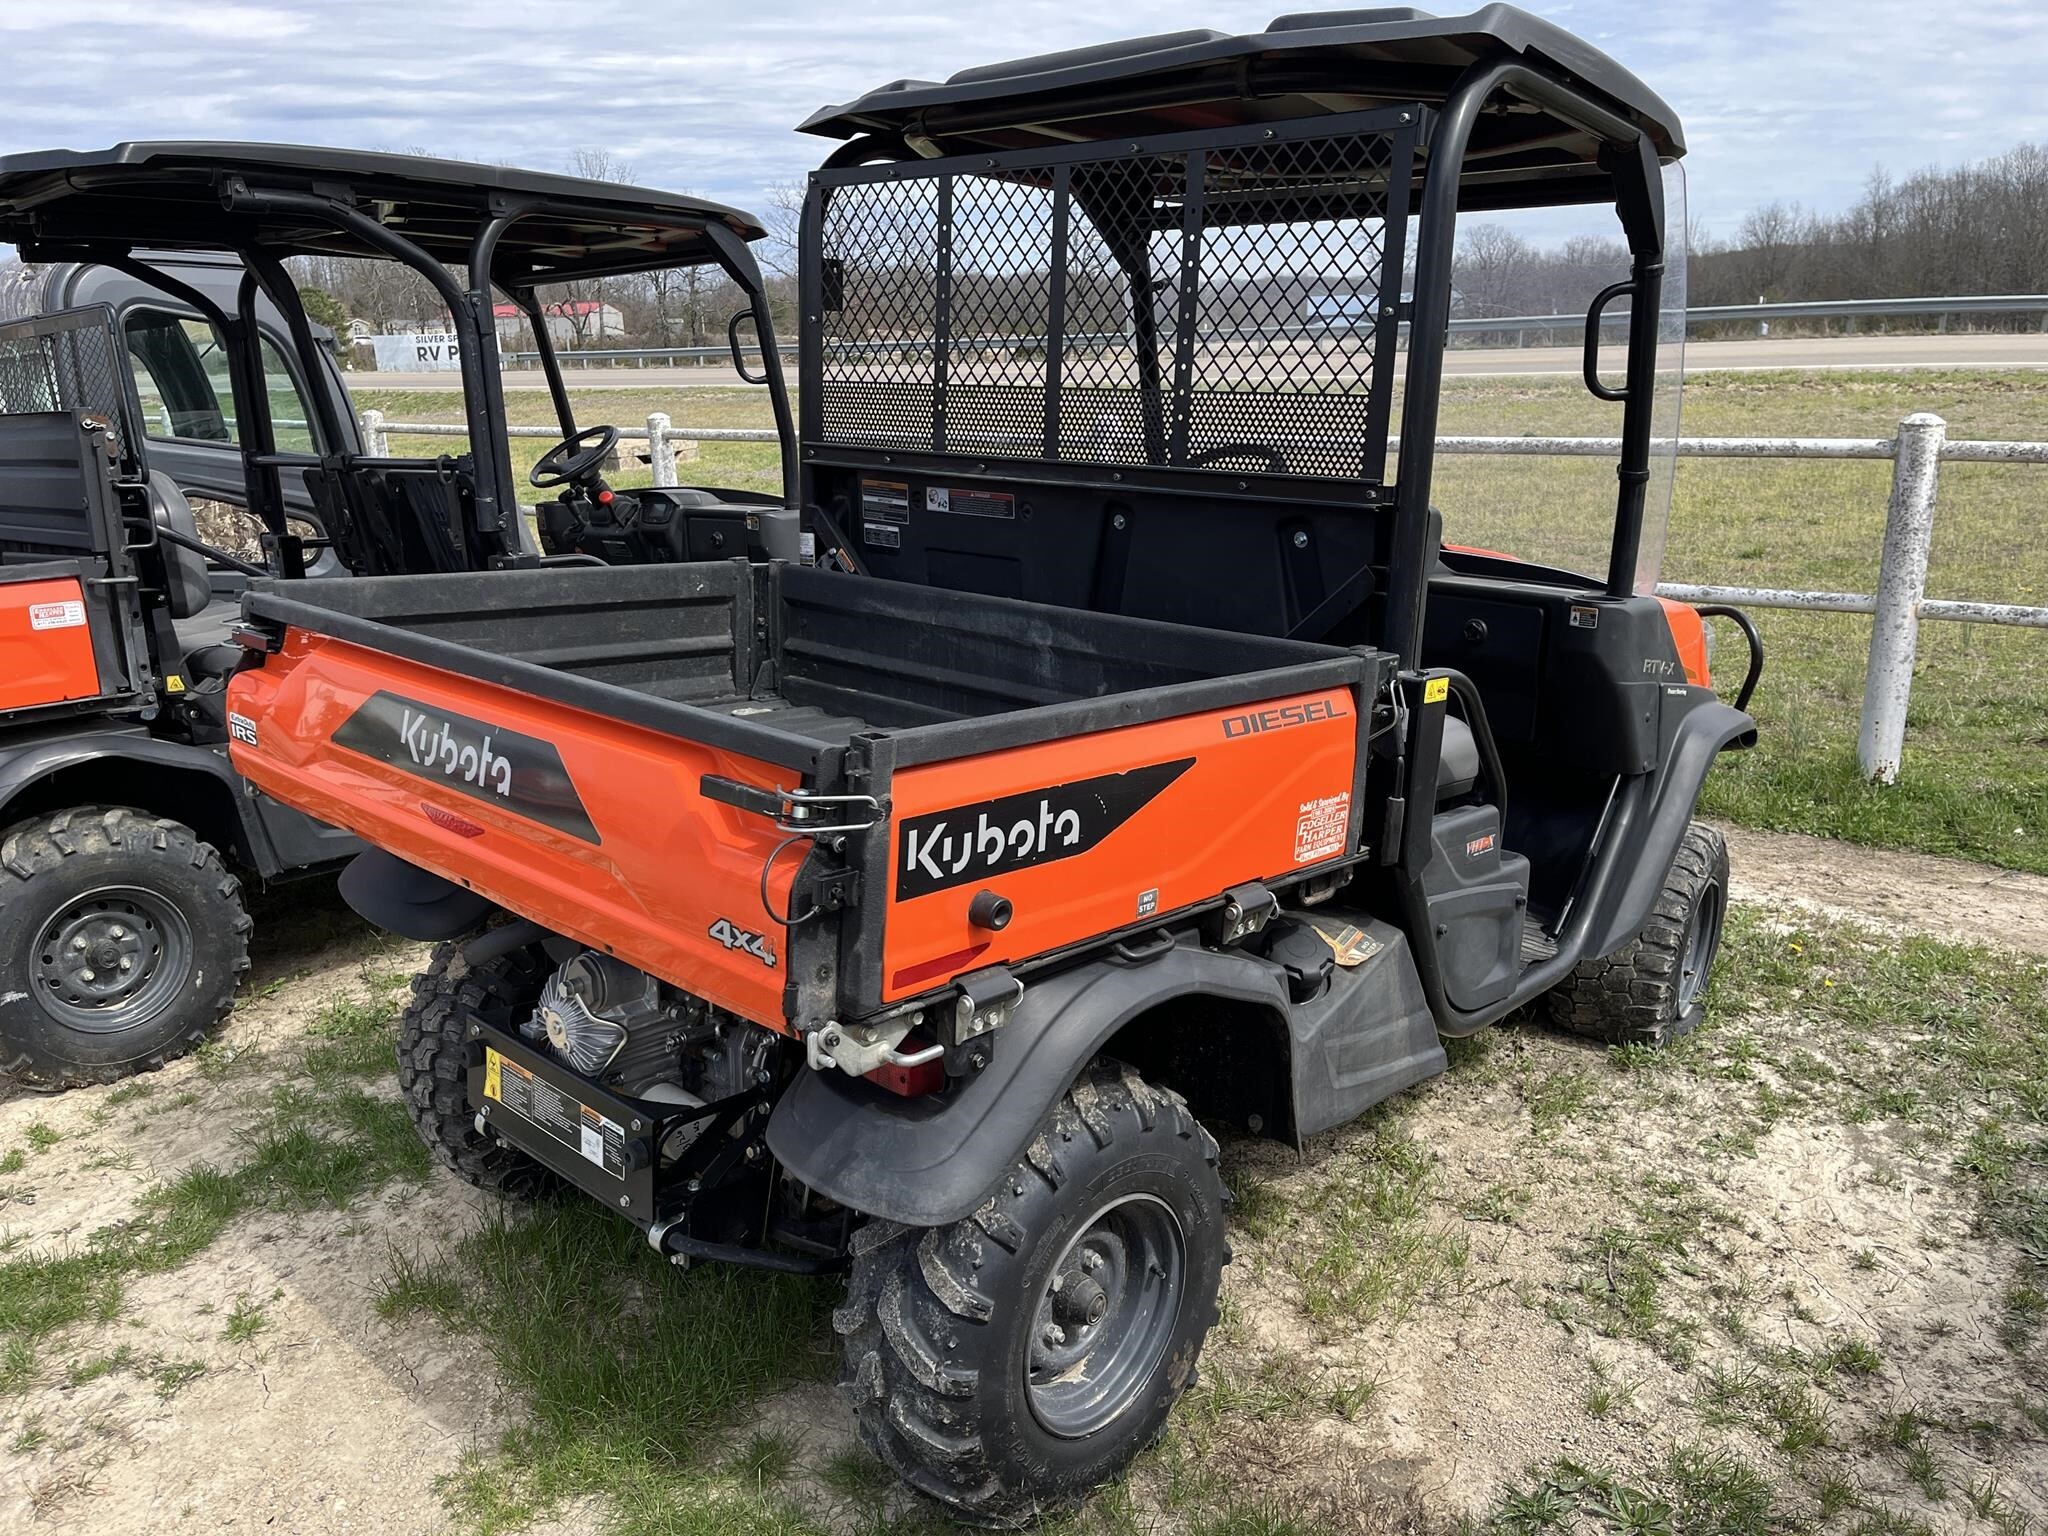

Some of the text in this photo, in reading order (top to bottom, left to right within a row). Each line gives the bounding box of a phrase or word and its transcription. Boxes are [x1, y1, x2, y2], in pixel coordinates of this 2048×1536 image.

[415, 335, 445, 344] SILVER
[416, 345, 441, 362] RV
[1642, 658, 1676, 676] RTV-X
[1221, 699, 1348, 739] DIESEL
[231, 723, 257, 746] IRS
[400, 708, 512, 797] Kubota
[906, 799, 1081, 880] Kubota
[1301, 825, 1343, 845] HARPER
[1138, 902, 1156, 913] STEP
[1143, 893, 1153, 904] NO
